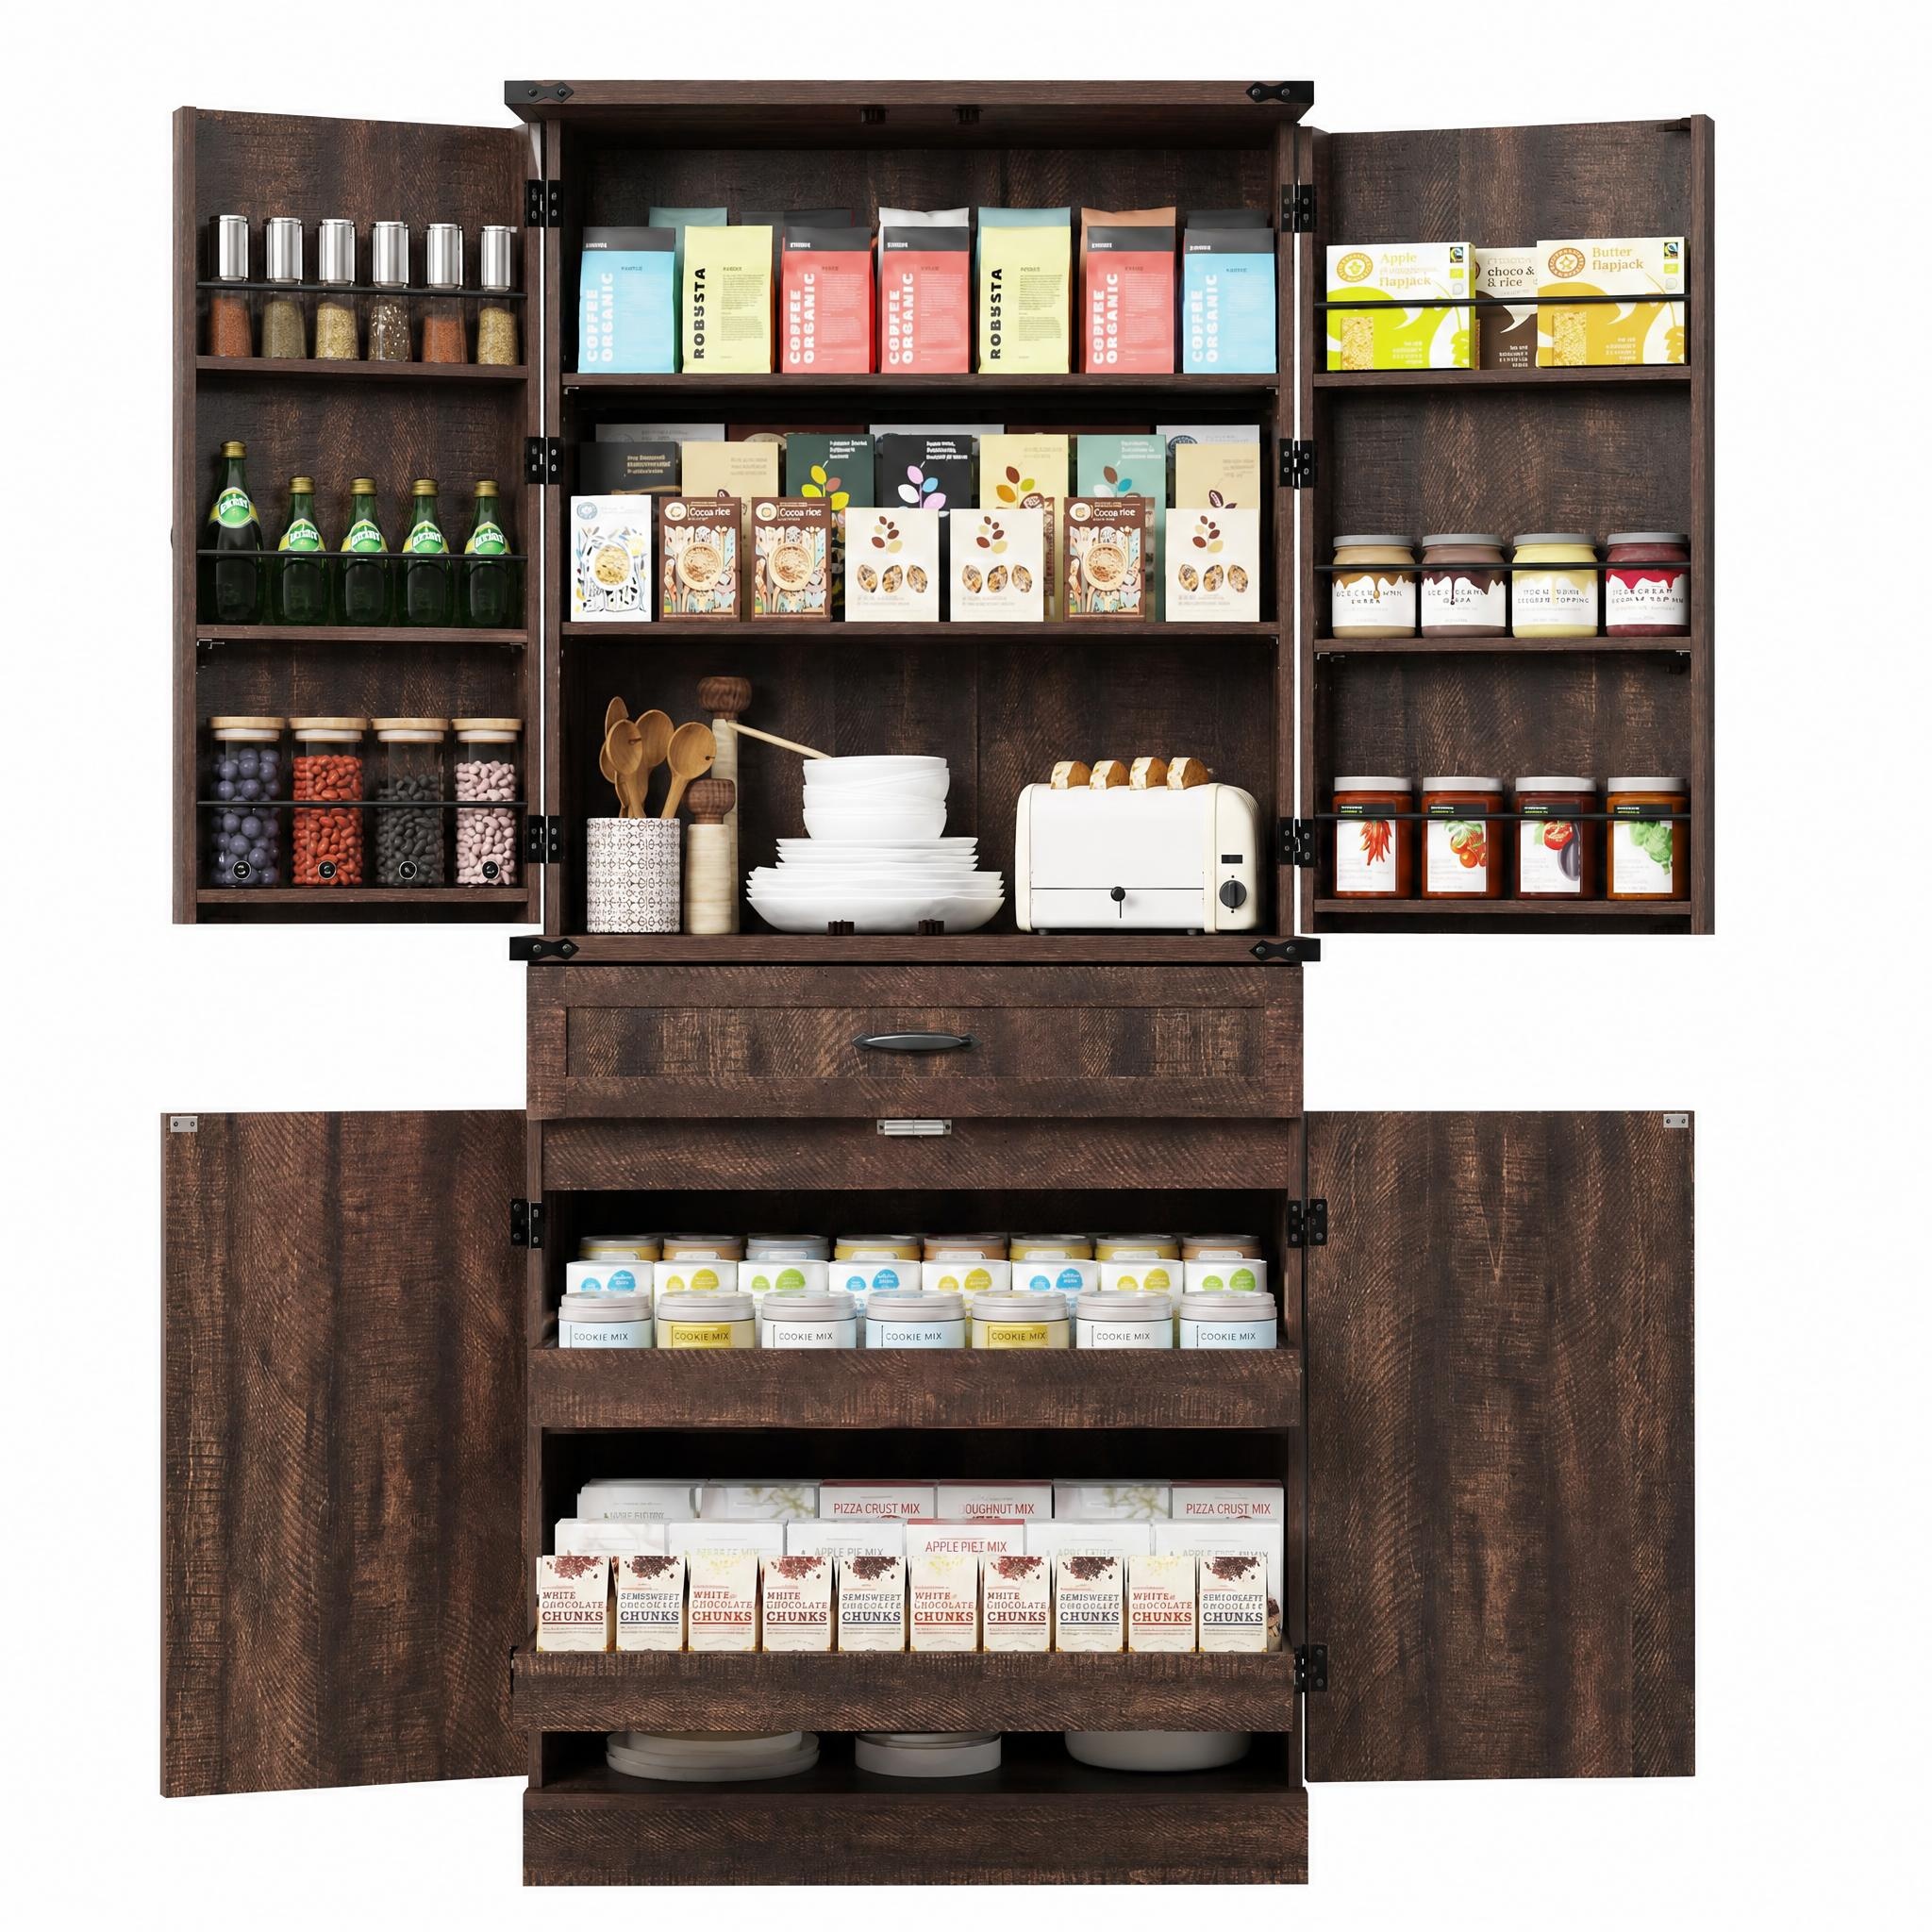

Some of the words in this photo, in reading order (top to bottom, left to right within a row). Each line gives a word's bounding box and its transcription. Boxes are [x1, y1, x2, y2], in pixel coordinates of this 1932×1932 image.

[1381, 252, 1417, 265] Apple
[1592, 247, 1632, 263] Butter
[1488, 266, 1524, 276] choco
[1525, 266, 1535, 275] &
[1592, 259, 1644, 274] flapjack
[1500, 277, 1523, 287] rice
[601, 273, 613, 362] ORGANIC
[804, 273, 815, 364] ORGANIC
[902, 273, 914, 364] ORGANIC
[1106, 274, 1118, 364] ORGANIC
[1205, 274, 1219, 363] ORGANIC
[690, 508, 714, 517] Cocoa
[715, 508, 731, 516] rice
[779, 508, 805, 517] Cocoa
[1093, 508, 1118, 517] Cocoa
[574, 1332, 607, 1341] COOKIE
[610, 1332, 628, 1341] MIX
[674, 1332, 708, 1341] COOKIE
[711, 1332, 729, 1341] MIX
[778, 1332, 813, 1341] COOKIE
[816, 1332, 833, 1341] MIX
[885, 1332, 920, 1341] COOKIE
[923, 1332, 941, 1341] MIX
[991, 1332, 1026, 1341] COOKIE
[1029, 1332, 1046, 1341] MIX
[1096, 1332, 1130, 1341] COOKIE
[1134, 1332, 1150, 1341] MIX
[1200, 1332, 1236, 1341] COOKIE
[1239, 1332, 1257, 1341] MIX
[834, 1503, 863, 1515] PIZZA
[865, 1503, 898, 1515] CRUST
[901, 1503, 921, 1515] MIX
[1015, 1504, 1035, 1514] MIX
[1186, 1503, 1214, 1515] PIZZA
[1217, 1503, 1249, 1515] CRUST
[1252, 1503, 1271, 1515] MIX
[925, 1541, 958, 1553] APPLE
[987, 1541, 1007, 1553] MIX
[693, 1591, 729, 1599] WHITE
[915, 1591, 951, 1600] WHITE
[541, 1611, 604, 1622] CHUNKS
[620, 1611, 679, 1622] CHUNKS
[691, 1611, 753, 1622] CHUNKS
[766, 1611, 827, 1622] CHUNKS
[841, 1611, 901, 1622] CHUNKS
[914, 1611, 974, 1622] CHUNKS
[987, 1611, 1047, 1622] CHUNKS
[1059, 1611, 1120, 1622] CHUNKS
[1131, 1611, 1192, 1622] CHUNKS
[1202, 1611, 1263, 1622] CHUNKS
